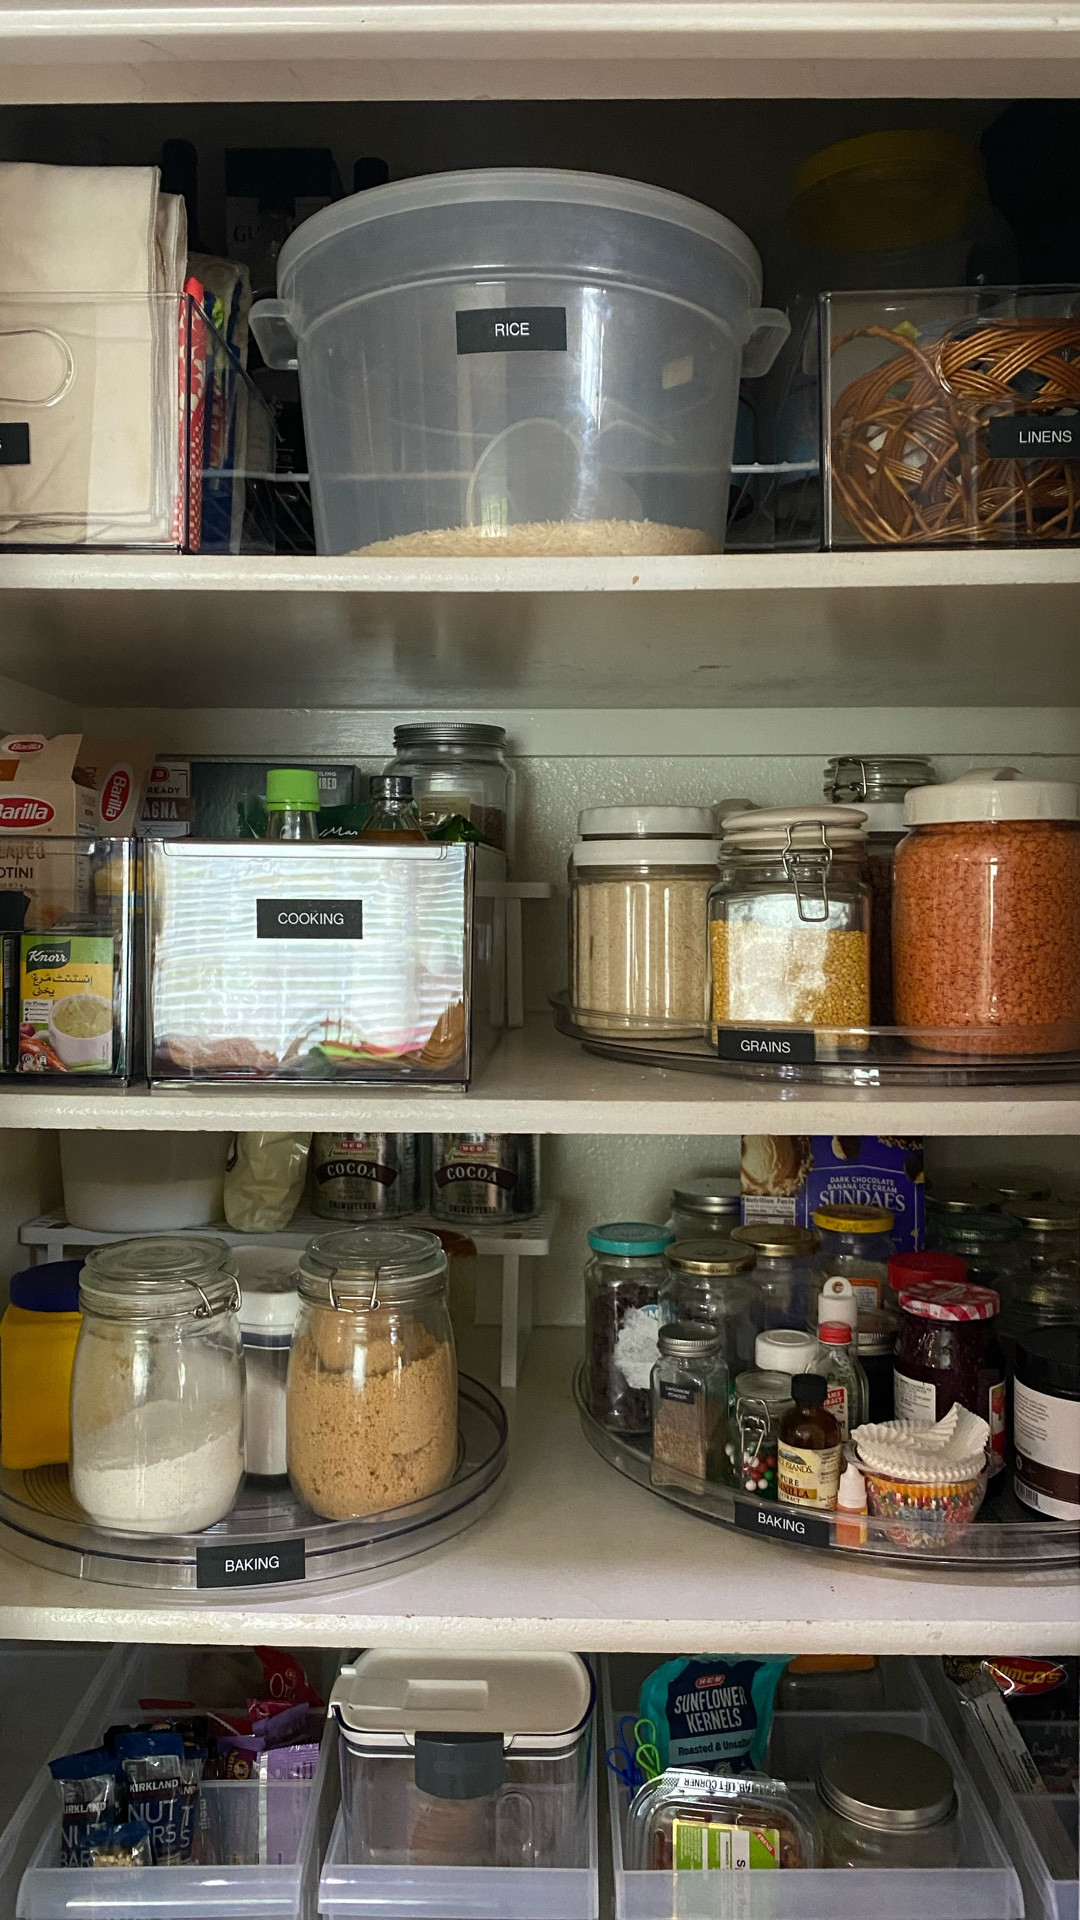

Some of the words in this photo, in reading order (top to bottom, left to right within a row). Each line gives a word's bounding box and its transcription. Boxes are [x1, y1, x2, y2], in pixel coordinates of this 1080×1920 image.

[494, 322, 530, 338] RICE
[1018, 430, 1073, 445] LINENS
[105, 775, 127, 818] Barilla
[146, 786, 180, 794] READY
[142, 800, 178, 819] AGNA
[0, 866, 34, 879] OTINI
[277, 912, 345, 926] COOKING
[28, 949, 68, 963] Knorr
[740, 1039, 792, 1055] GRAINS
[326, 1162, 378, 1179] COCOA
[446, 1166, 498, 1182] COCOA
[827, 1183, 857, 1192] BANANA
[873, 1184, 898, 1194] CREAM
[830, 1176, 850, 1184] DARK
[852, 1176, 895, 1187] CHOCOLATE
[745, 1196, 775, 1204] Nutrition
[776, 1197, 795, 1205] Facts
[819, 1189, 906, 1212] SUNDAES
[827, 1391, 841, 1399] AMS
[785, 1461, 813, 1474] ISLANDS
[780, 1473, 800, 1487] PURE
[779, 1481, 810, 1499] ANILLA
[757, 1511, 806, 1536] BAKING
[225, 1555, 280, 1573] BAKING
[674, 1686, 748, 1714] SUNFLOWER
[685, 1708, 743, 1734] KERNELS
[678, 1742, 714, 1757] Roasted
[715, 1742, 722, 1751] &
[129, 1779, 179, 1794] KIRKLAND
[684, 1778, 718, 1790] CORNER
[718, 1781, 736, 1792] LIFT
[128, 1798, 178, 1824] NUT
[152, 1825, 177, 1844] RS
[757, 1833, 773, 1852] FRESH
